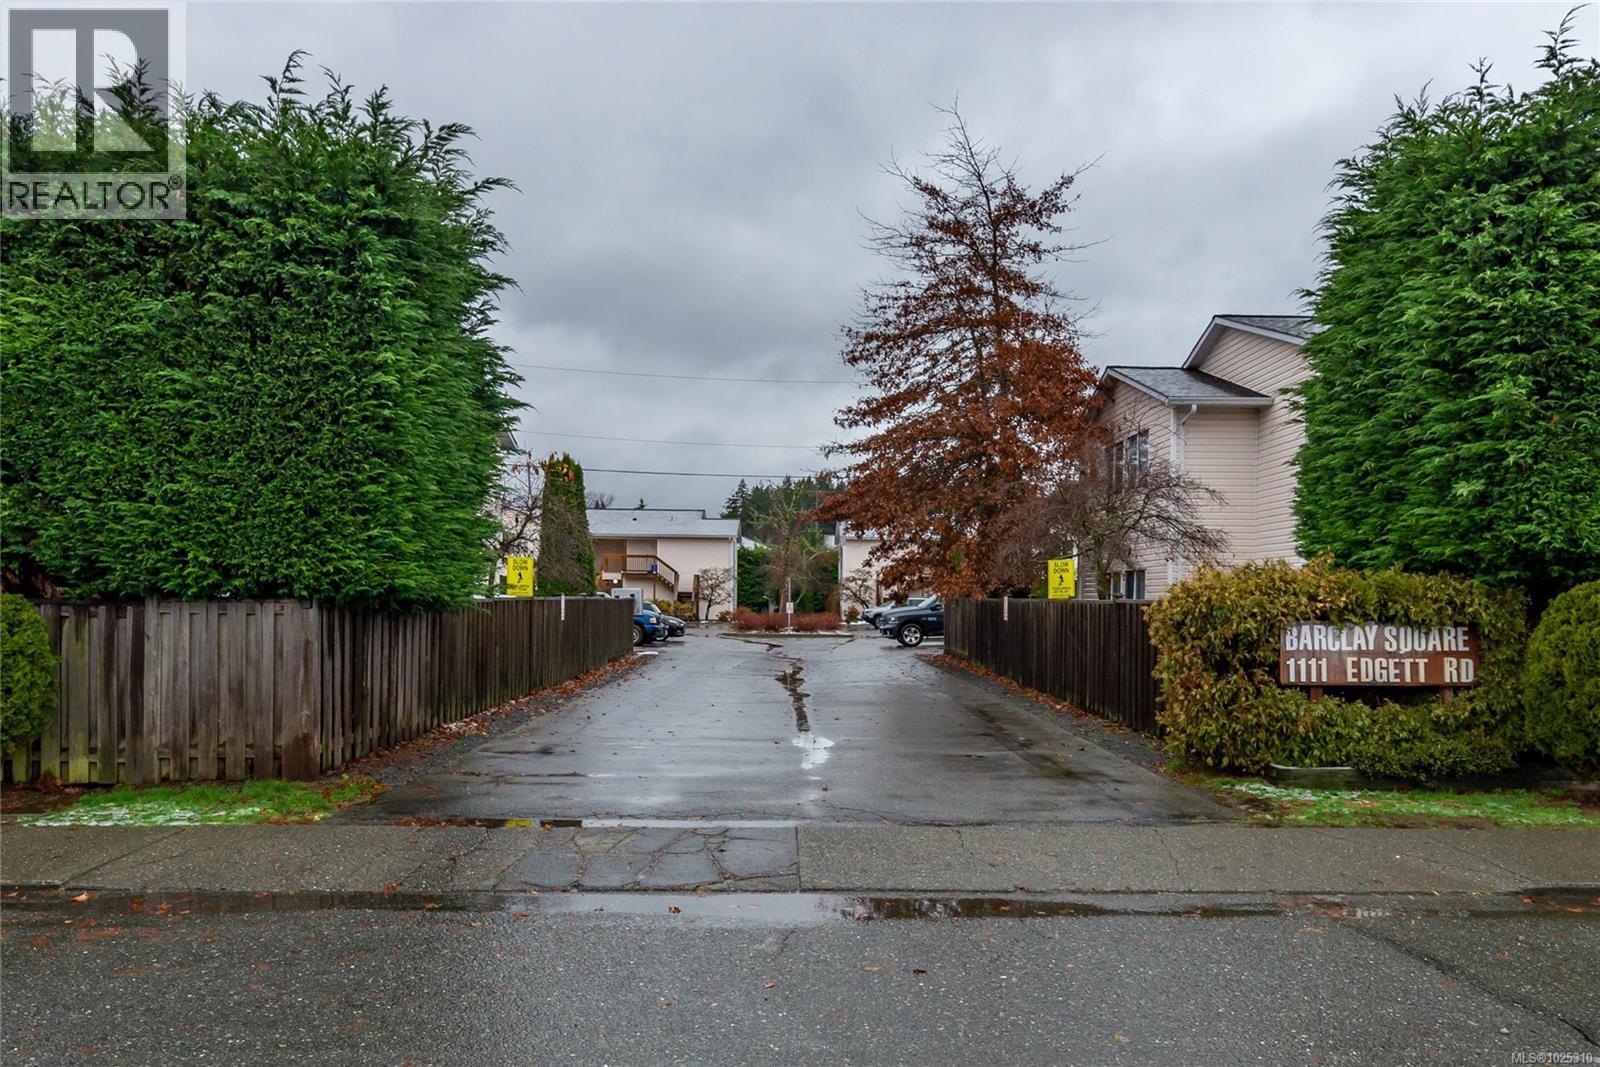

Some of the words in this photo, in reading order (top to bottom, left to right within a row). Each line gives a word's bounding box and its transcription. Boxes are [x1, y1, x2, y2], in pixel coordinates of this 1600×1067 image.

[1285, 624, 1378, 651] BARCLAY
[1384, 626, 1470, 654] SQUARE
[1286, 657, 1328, 683] 1111
[1346, 657, 1429, 683] EDGETT
[1443, 657, 1475, 683] RD
